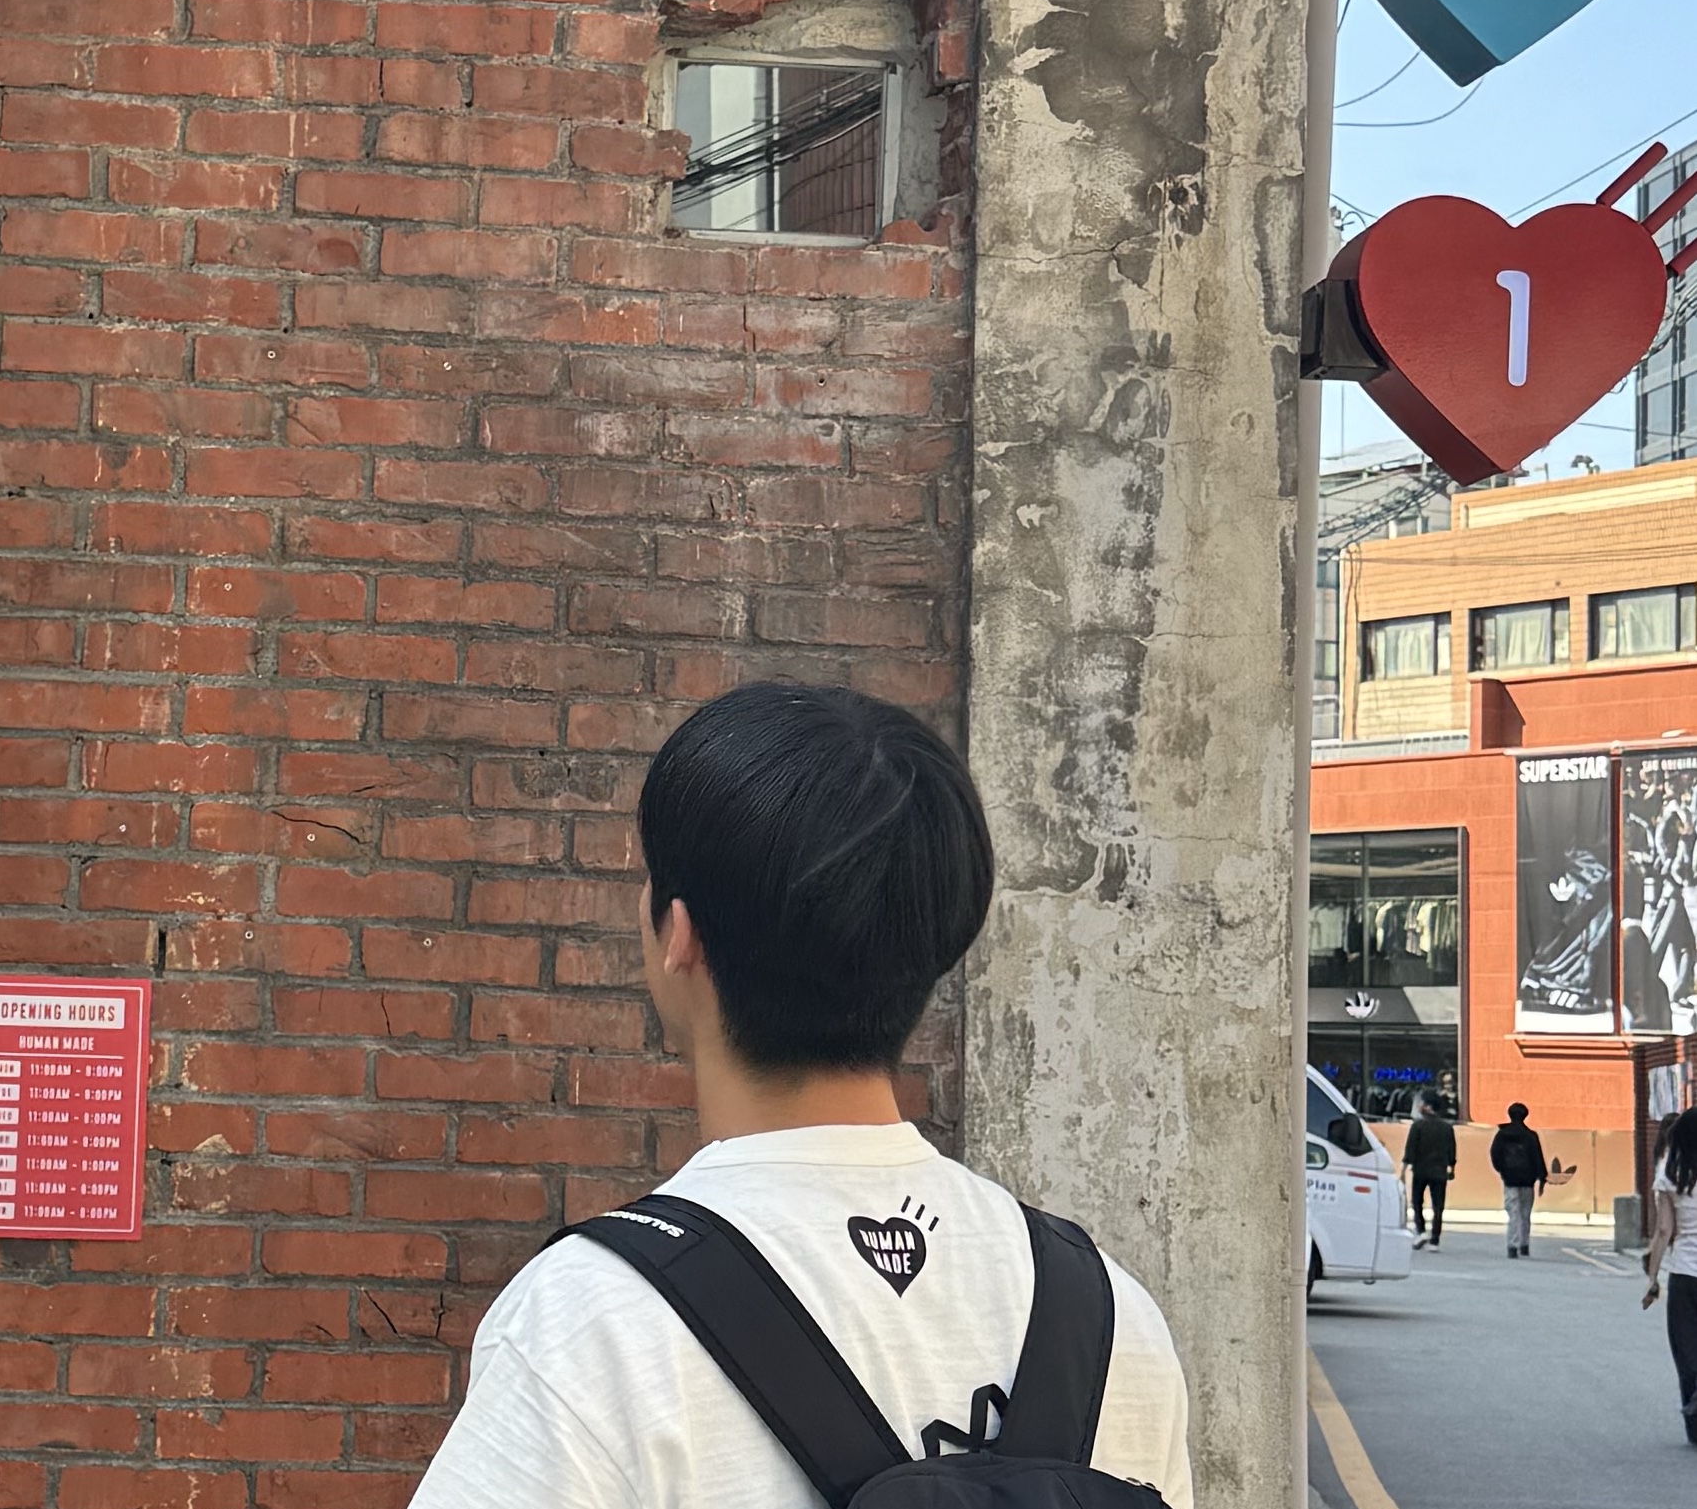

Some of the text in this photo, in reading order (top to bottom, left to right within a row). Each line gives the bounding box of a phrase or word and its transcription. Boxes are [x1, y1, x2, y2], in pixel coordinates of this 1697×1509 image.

[1495, 269, 1532, 387] 1
[1519, 756, 1608, 783] SUPERSTAR
[1, 1002, 116, 1022] OPENING HOURS
[18, 1035, 95, 1051] HUMAN MADE
[30, 1063, 71, 1076] 11:00AM
[29, 1087, 70, 1100] 11:00AM
[28, 1111, 69, 1123] 11:00AM
[27, 1134, 68, 1147] 11:00AM
[26, 1158, 67, 1170] 11:00AM
[25, 1182, 66, 1194] 11:00AM
[24, 1205, 65, 1218] 11:00AM
[859, 1229, 916, 1251] HUMAN
[872, 1250, 913, 1275] MADE
